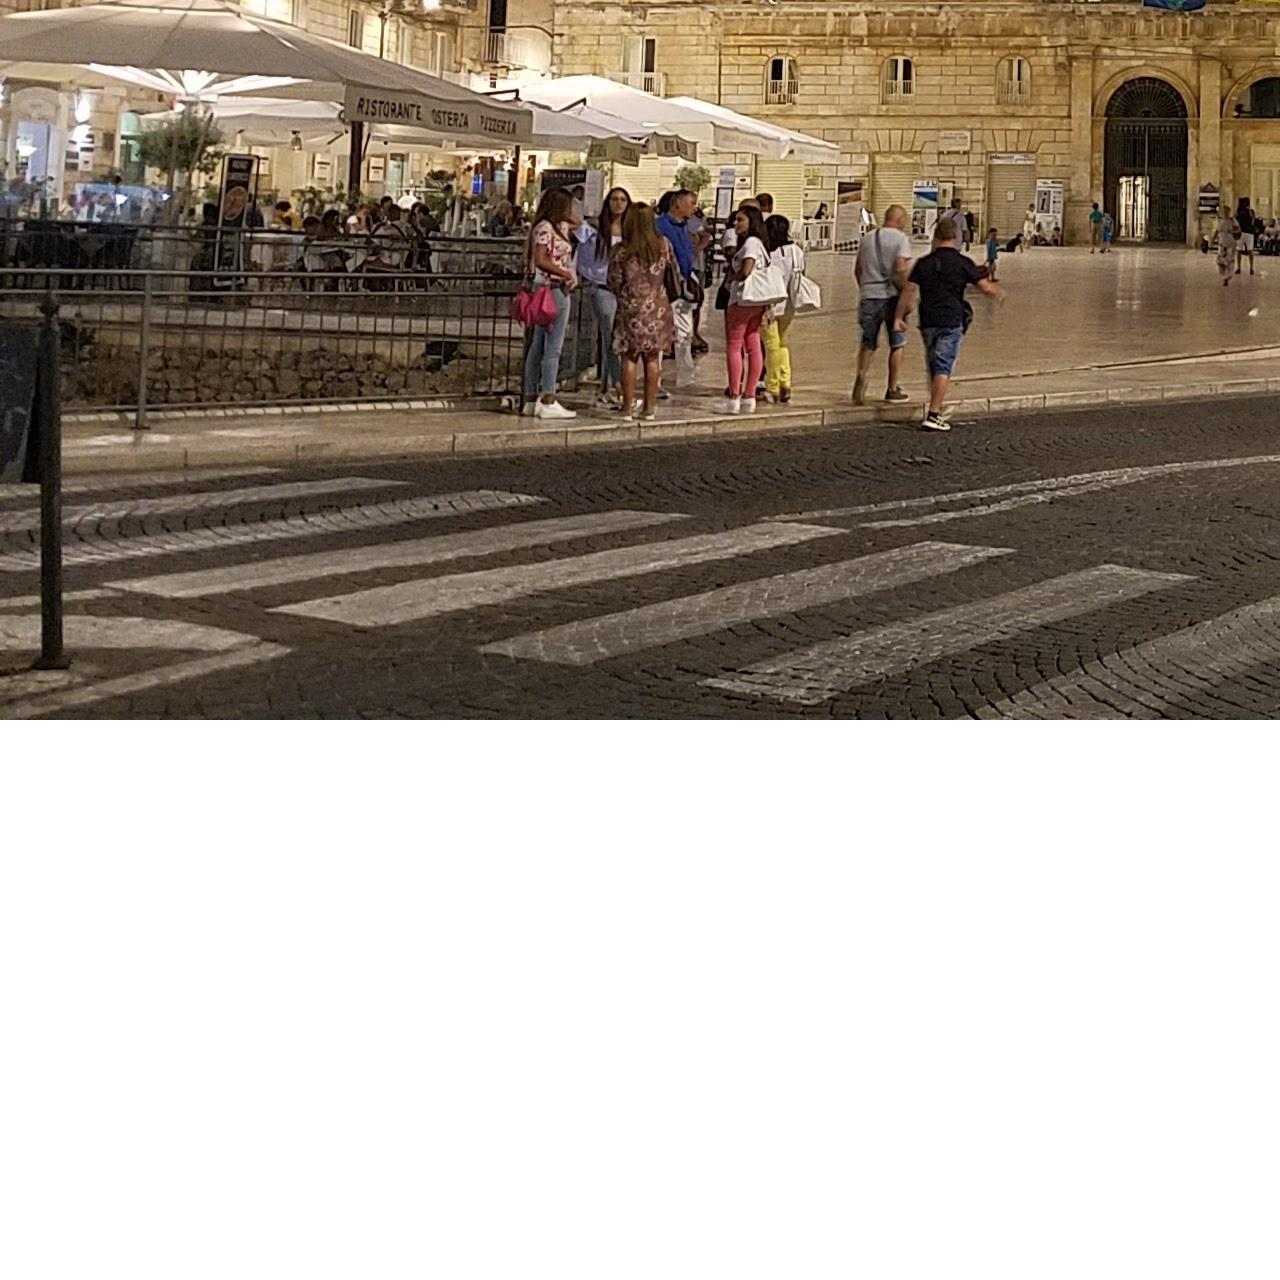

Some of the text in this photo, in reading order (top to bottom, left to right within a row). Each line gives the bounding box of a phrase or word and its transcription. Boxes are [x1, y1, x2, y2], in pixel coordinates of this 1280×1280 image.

[357, 97, 516, 135] RISTORANTE OSTERIA PIZZERIA
